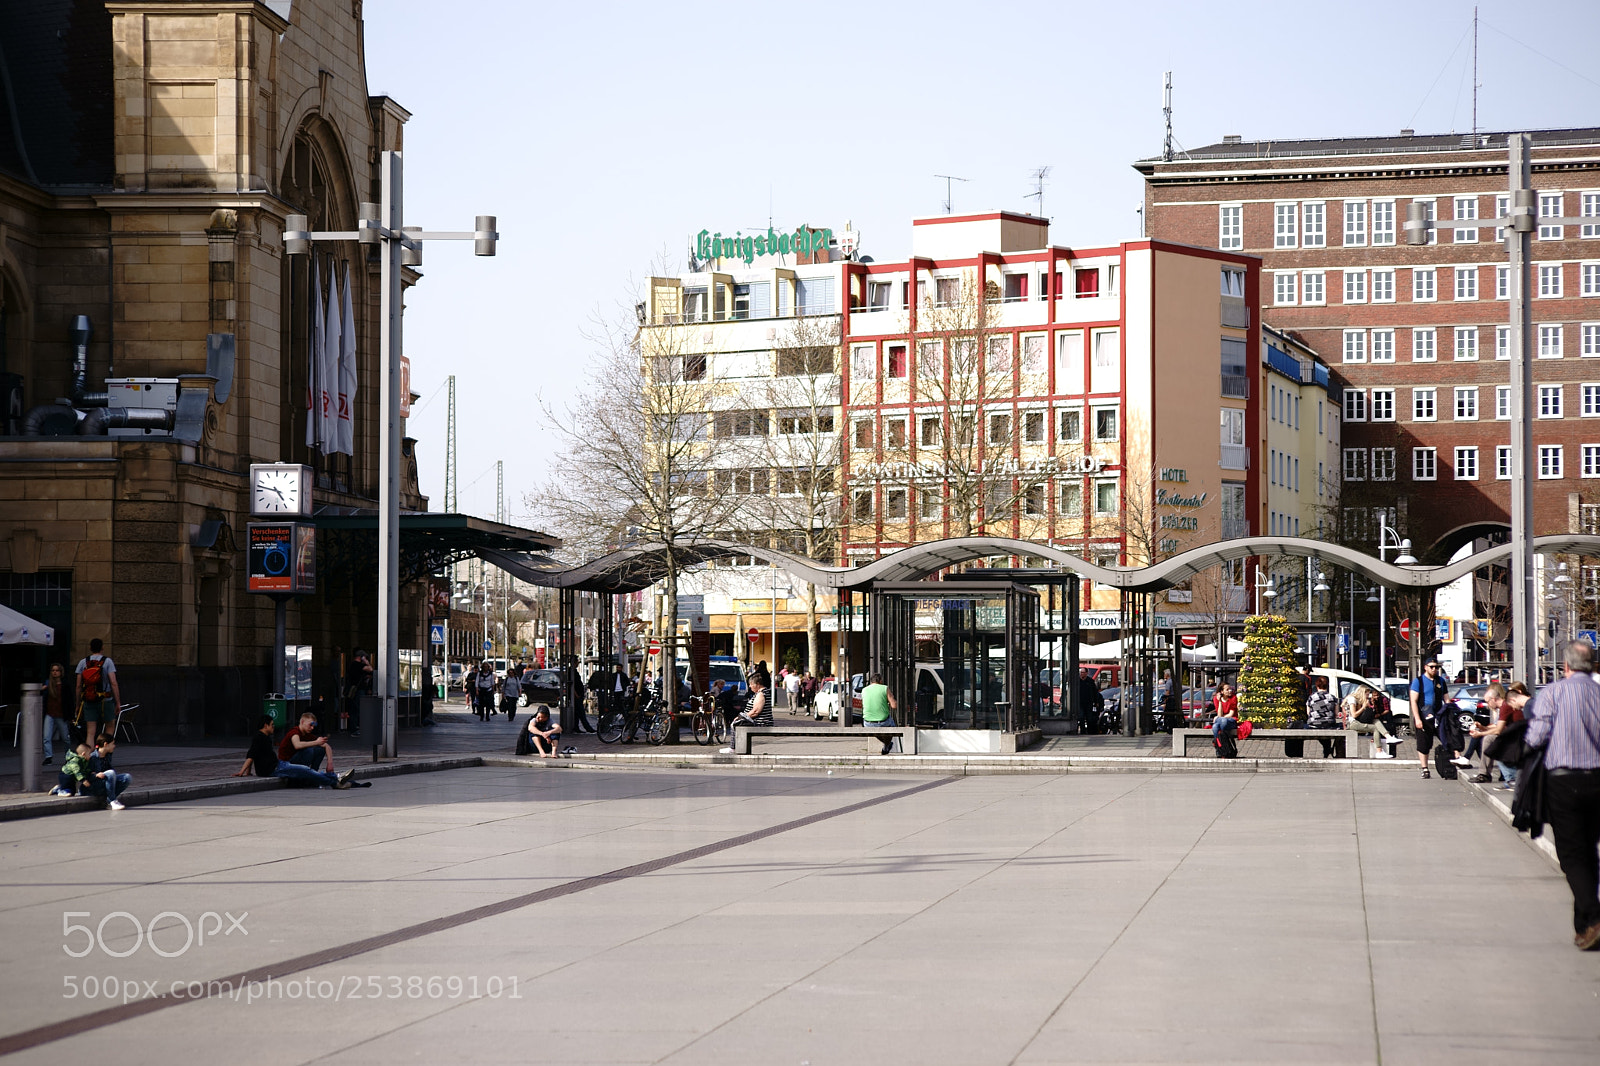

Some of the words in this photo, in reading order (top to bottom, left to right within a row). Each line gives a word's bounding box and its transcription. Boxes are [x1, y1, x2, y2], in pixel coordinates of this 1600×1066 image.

[697, 223, 832, 264] Königsbacher
[1160, 467, 1189, 483] HOTEL
[1160, 539, 1179, 553] HOF
[914, 599, 970, 610] TIEFGARAGE
